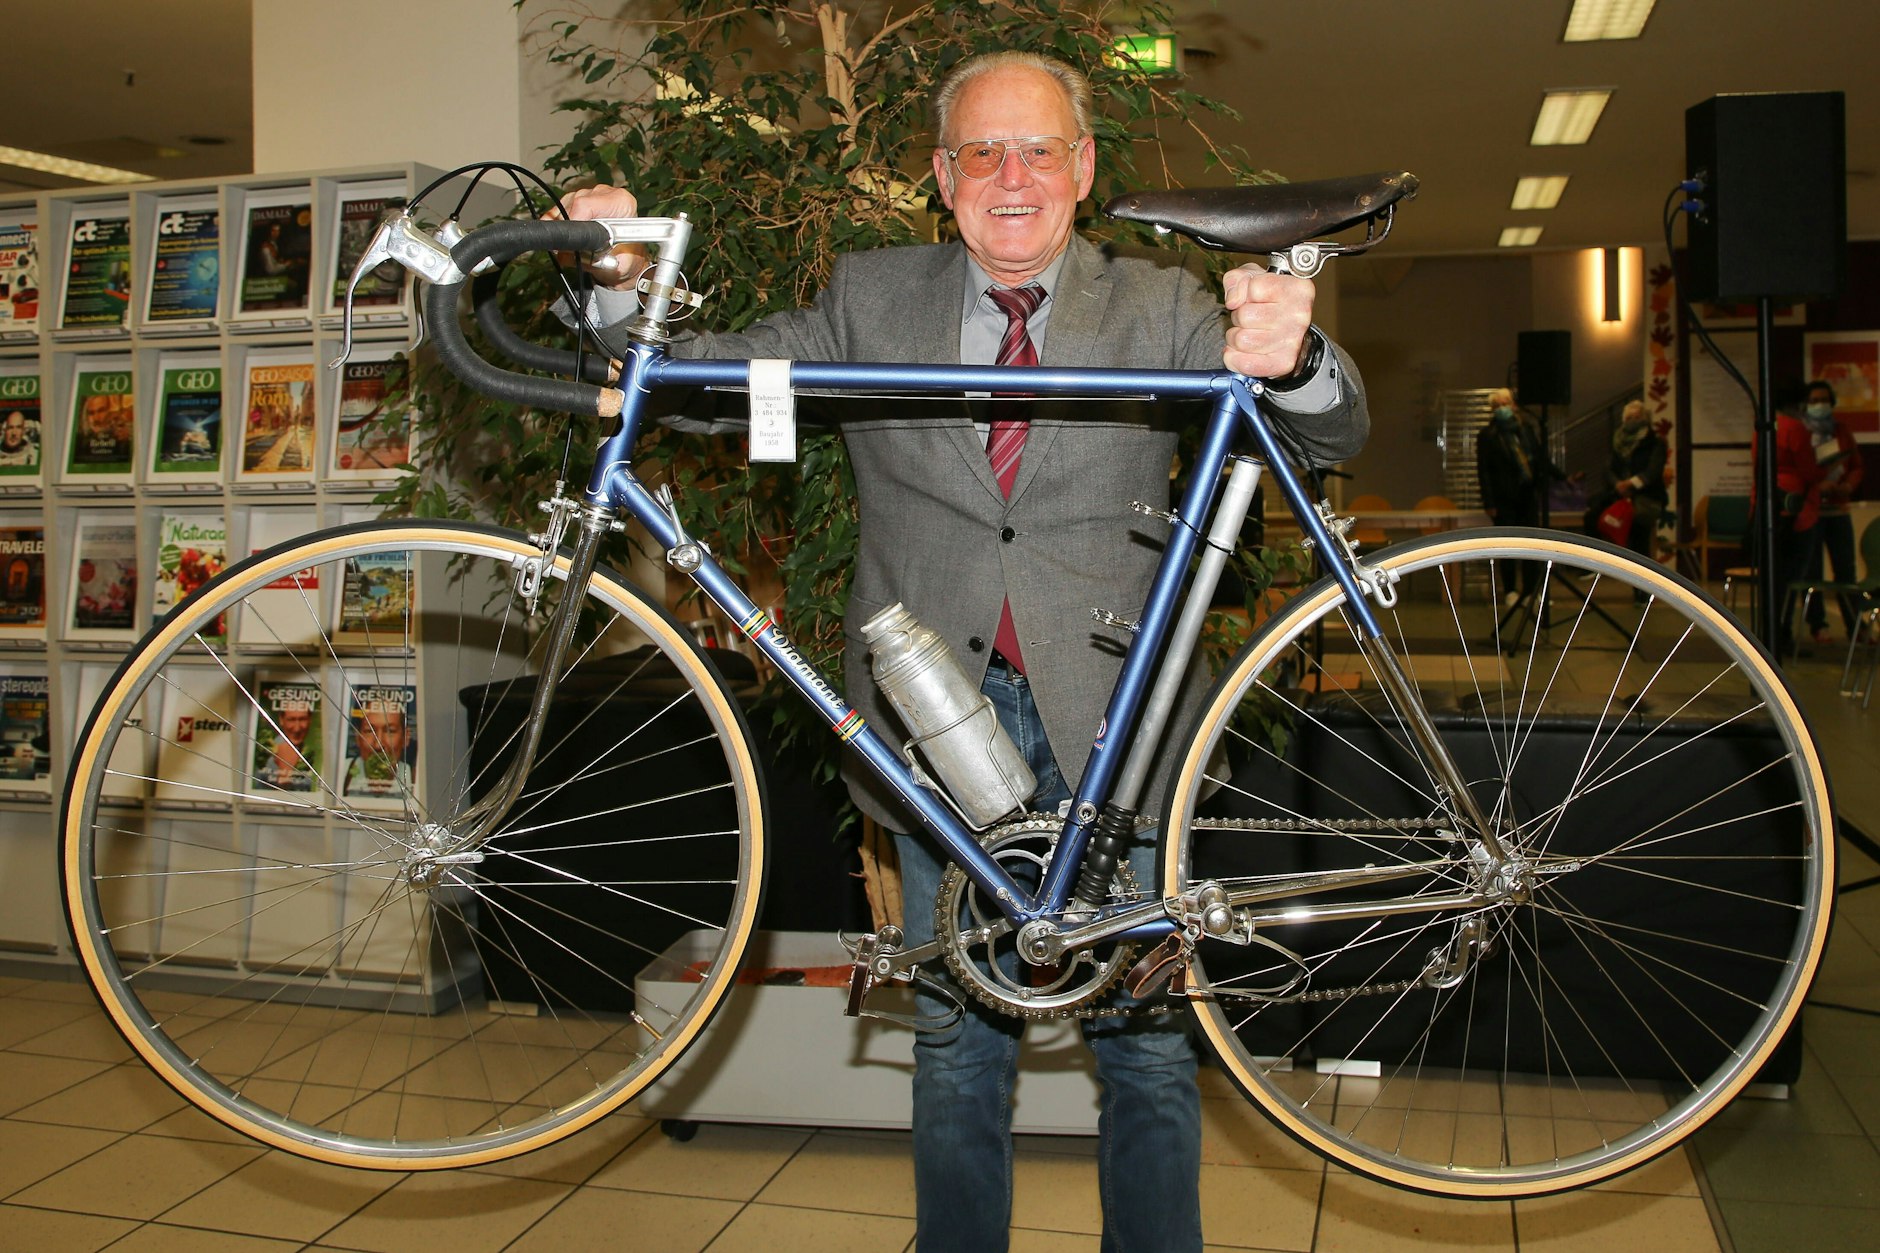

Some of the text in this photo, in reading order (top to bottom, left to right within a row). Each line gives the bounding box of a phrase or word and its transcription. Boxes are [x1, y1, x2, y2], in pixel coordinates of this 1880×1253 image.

[346, 202, 386, 213] DAMALS
[253, 208, 292, 220] DAMALS
[251, 369, 278, 383] GEO
[349, 366, 373, 378] GEO
[91, 374, 129, 393] GEO
[177, 370, 215, 389] GEO
[2, 378, 37, 395] GEO
[251, 388, 289, 406] Rom
[759, 430, 783, 438] Baujahr
[768, 627, 846, 710] Diamant
[268, 689, 321, 701] GESUND
[358, 690, 414, 702] GESUND
[272, 700, 315, 712] LEBEN
[363, 702, 406, 713] LEBEN
[195, 719, 231, 731] stern
